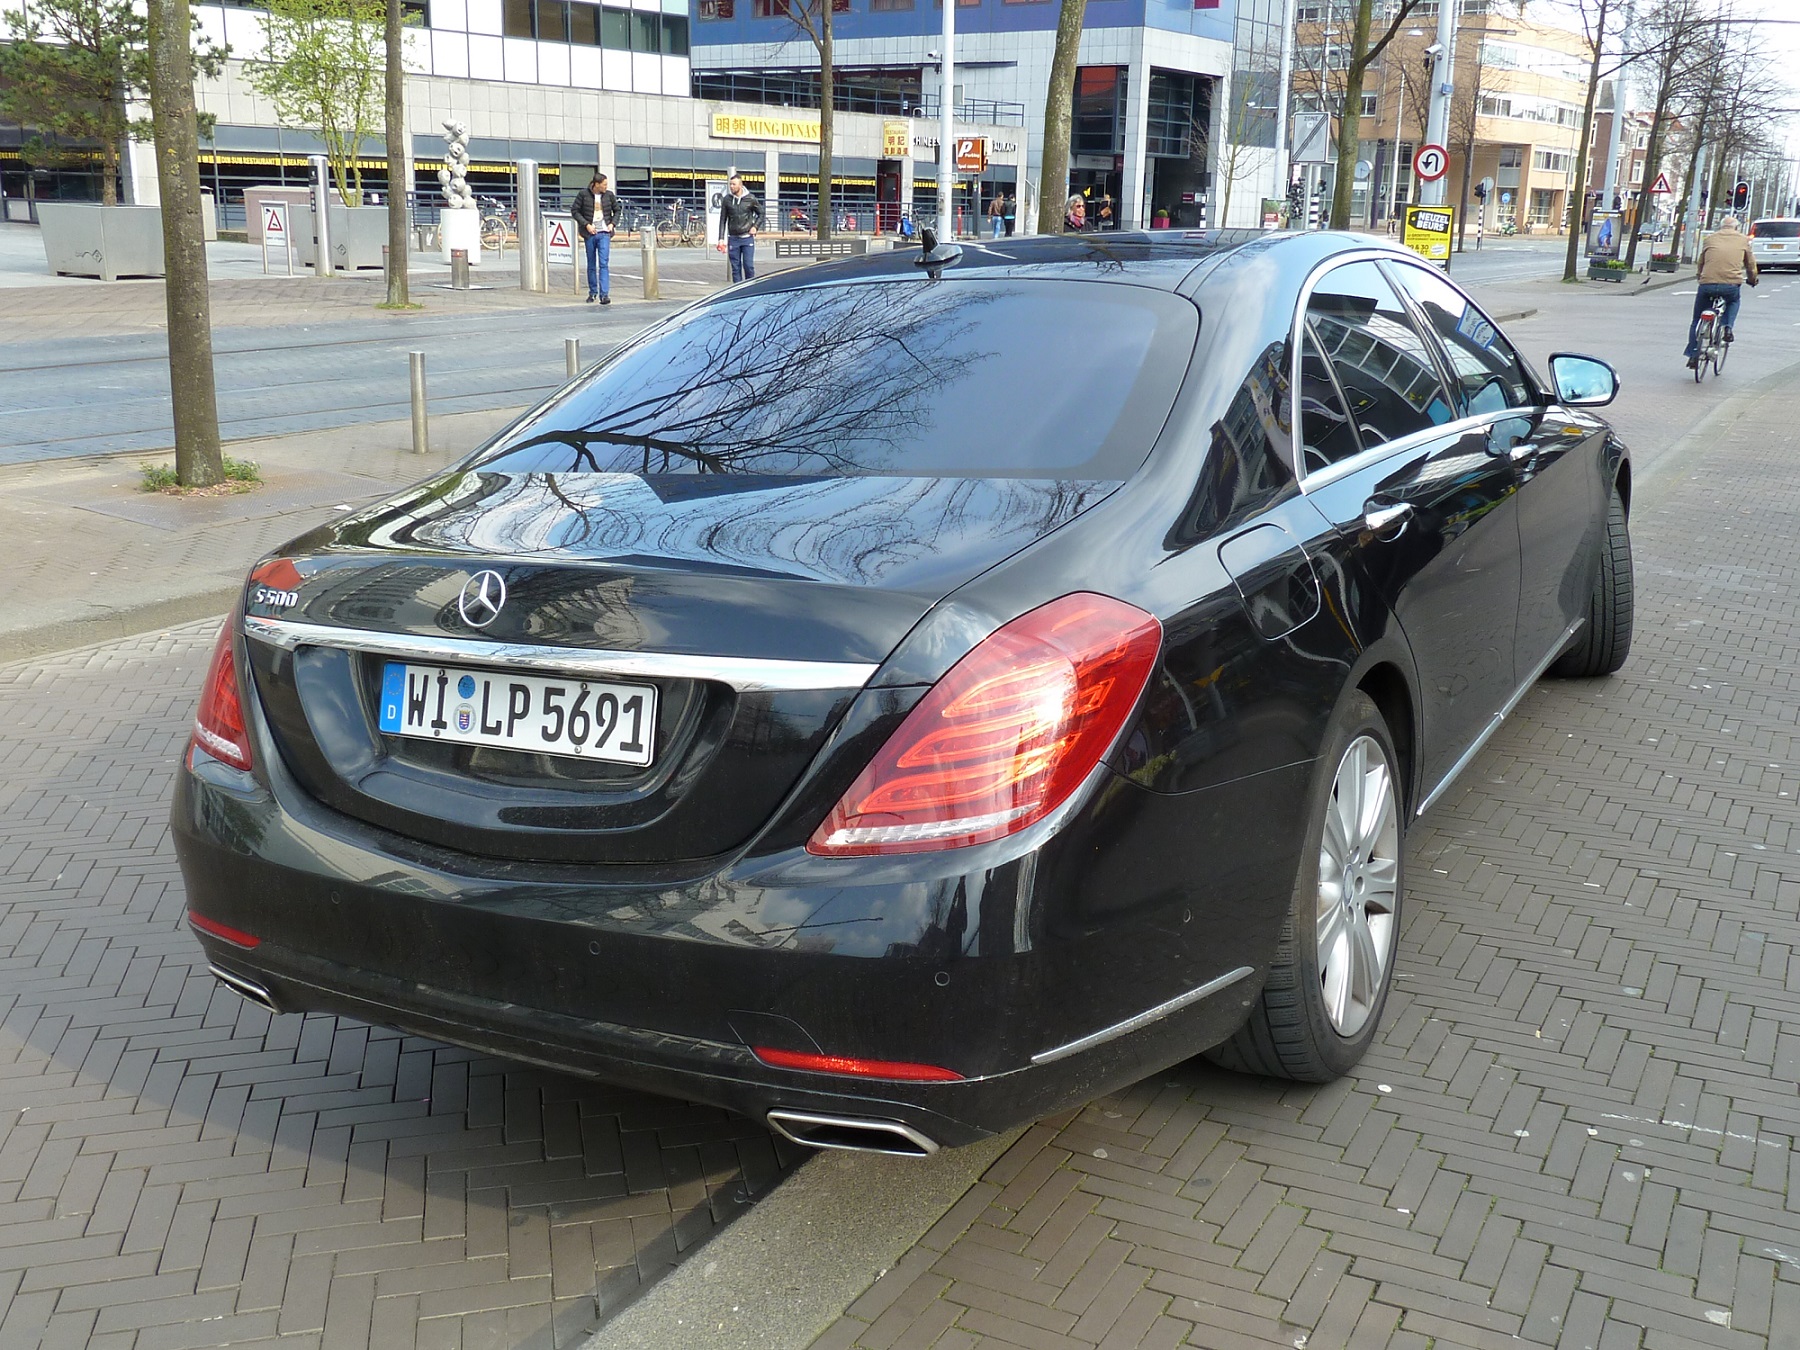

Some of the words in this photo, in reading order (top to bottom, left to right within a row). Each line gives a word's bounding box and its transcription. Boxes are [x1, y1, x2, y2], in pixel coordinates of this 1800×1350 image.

[716, 118, 746, 135] 明朝
[749, 121, 779, 136] MING
[782, 123, 821, 139] DYNAS
[1416, 220, 1445, 232] BEURS
[1418, 212, 1449, 225] NEUZEL
[387, 705, 397, 720] D
[408, 673, 449, 730] WI
[480, 680, 531, 738] LP
[541, 687, 643, 753] 5691
